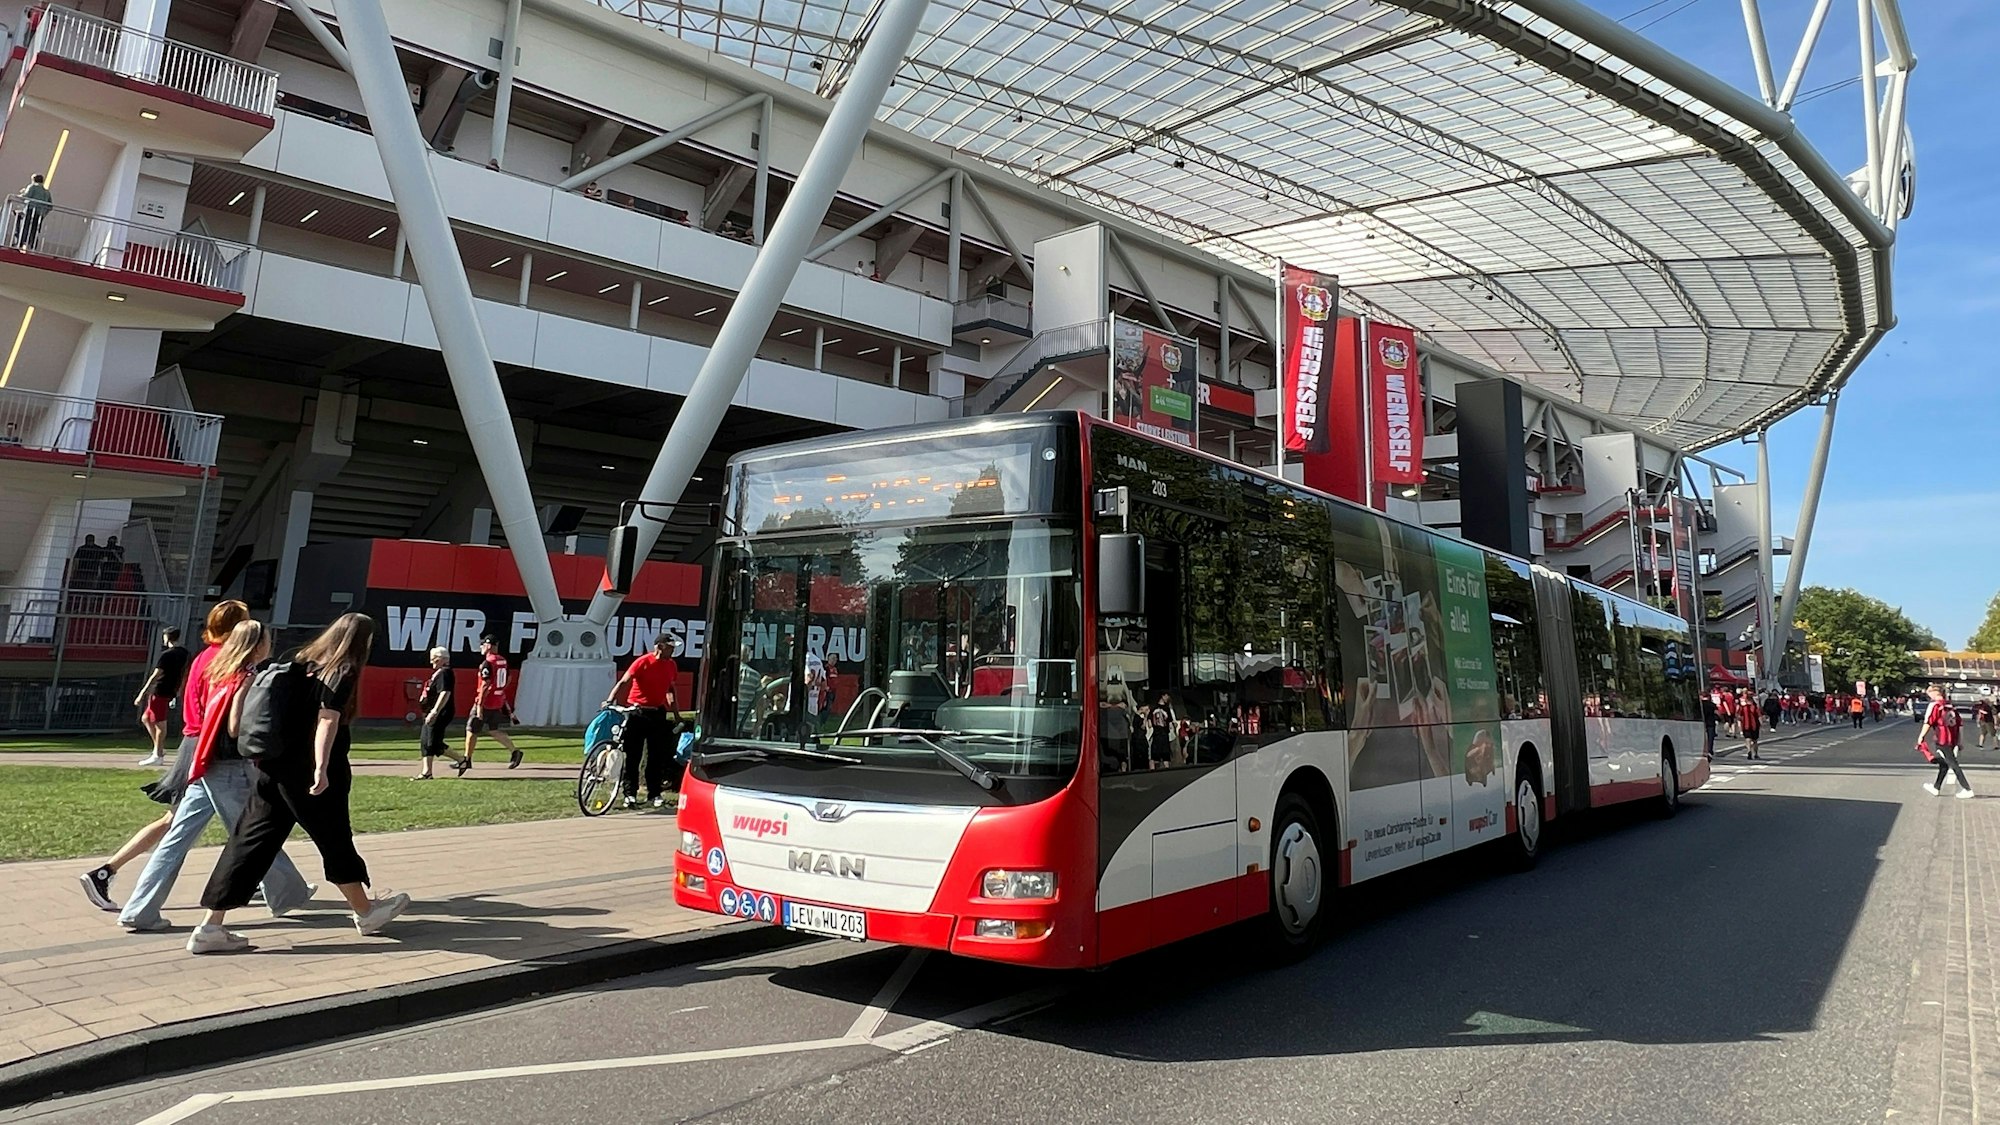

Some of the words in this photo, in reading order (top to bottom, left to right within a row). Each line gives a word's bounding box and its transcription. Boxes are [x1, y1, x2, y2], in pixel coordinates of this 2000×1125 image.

[1295, 326, 1323, 441] WERKSELF
[1386, 374, 1411, 473] WERKSELF
[1117, 454, 1147, 473] MAN
[1152, 479, 1167, 498] 203
[1446, 568, 1466, 596] Eins
[1467, 572, 1480, 599] für
[387, 606, 486, 652] WIR
[607, 616, 777, 660] UNSEEN
[1450, 606, 1471, 633] alle!
[733, 812, 788, 837] wupsi
[1364, 829, 1373, 841] Die
[788, 850, 866, 880] MAN
[791, 906, 813, 926] LEV
[822, 911, 837, 930] WU
[840, 914, 863, 934] 203
